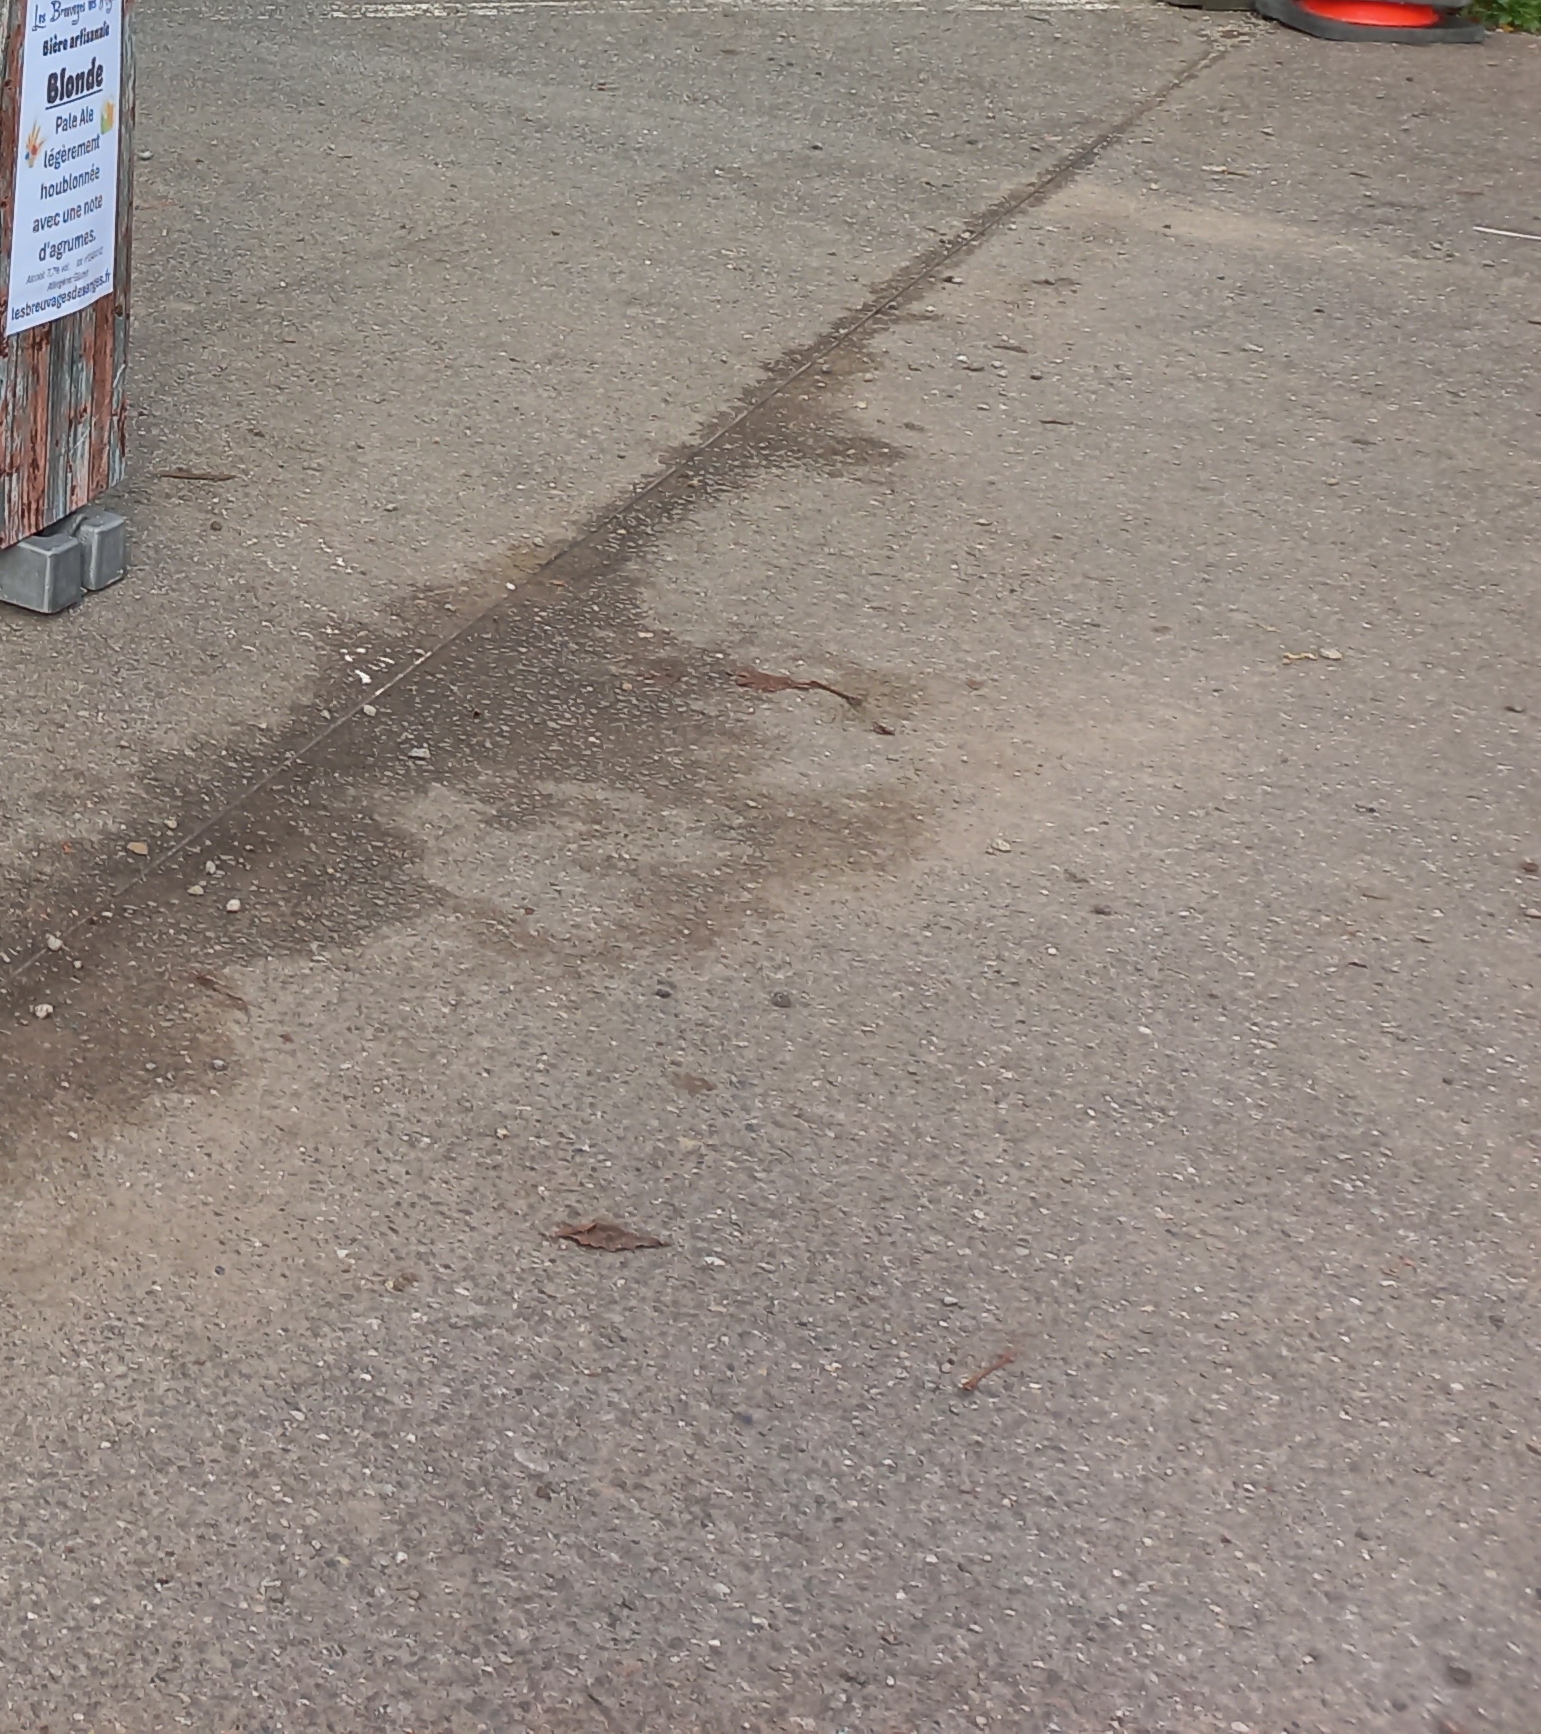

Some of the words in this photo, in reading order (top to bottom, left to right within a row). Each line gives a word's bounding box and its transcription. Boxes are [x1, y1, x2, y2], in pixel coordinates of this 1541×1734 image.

[46, 57, 103, 105] Blonde
[55, 114, 77, 135] Pale
[79, 105, 94, 127] Ale
